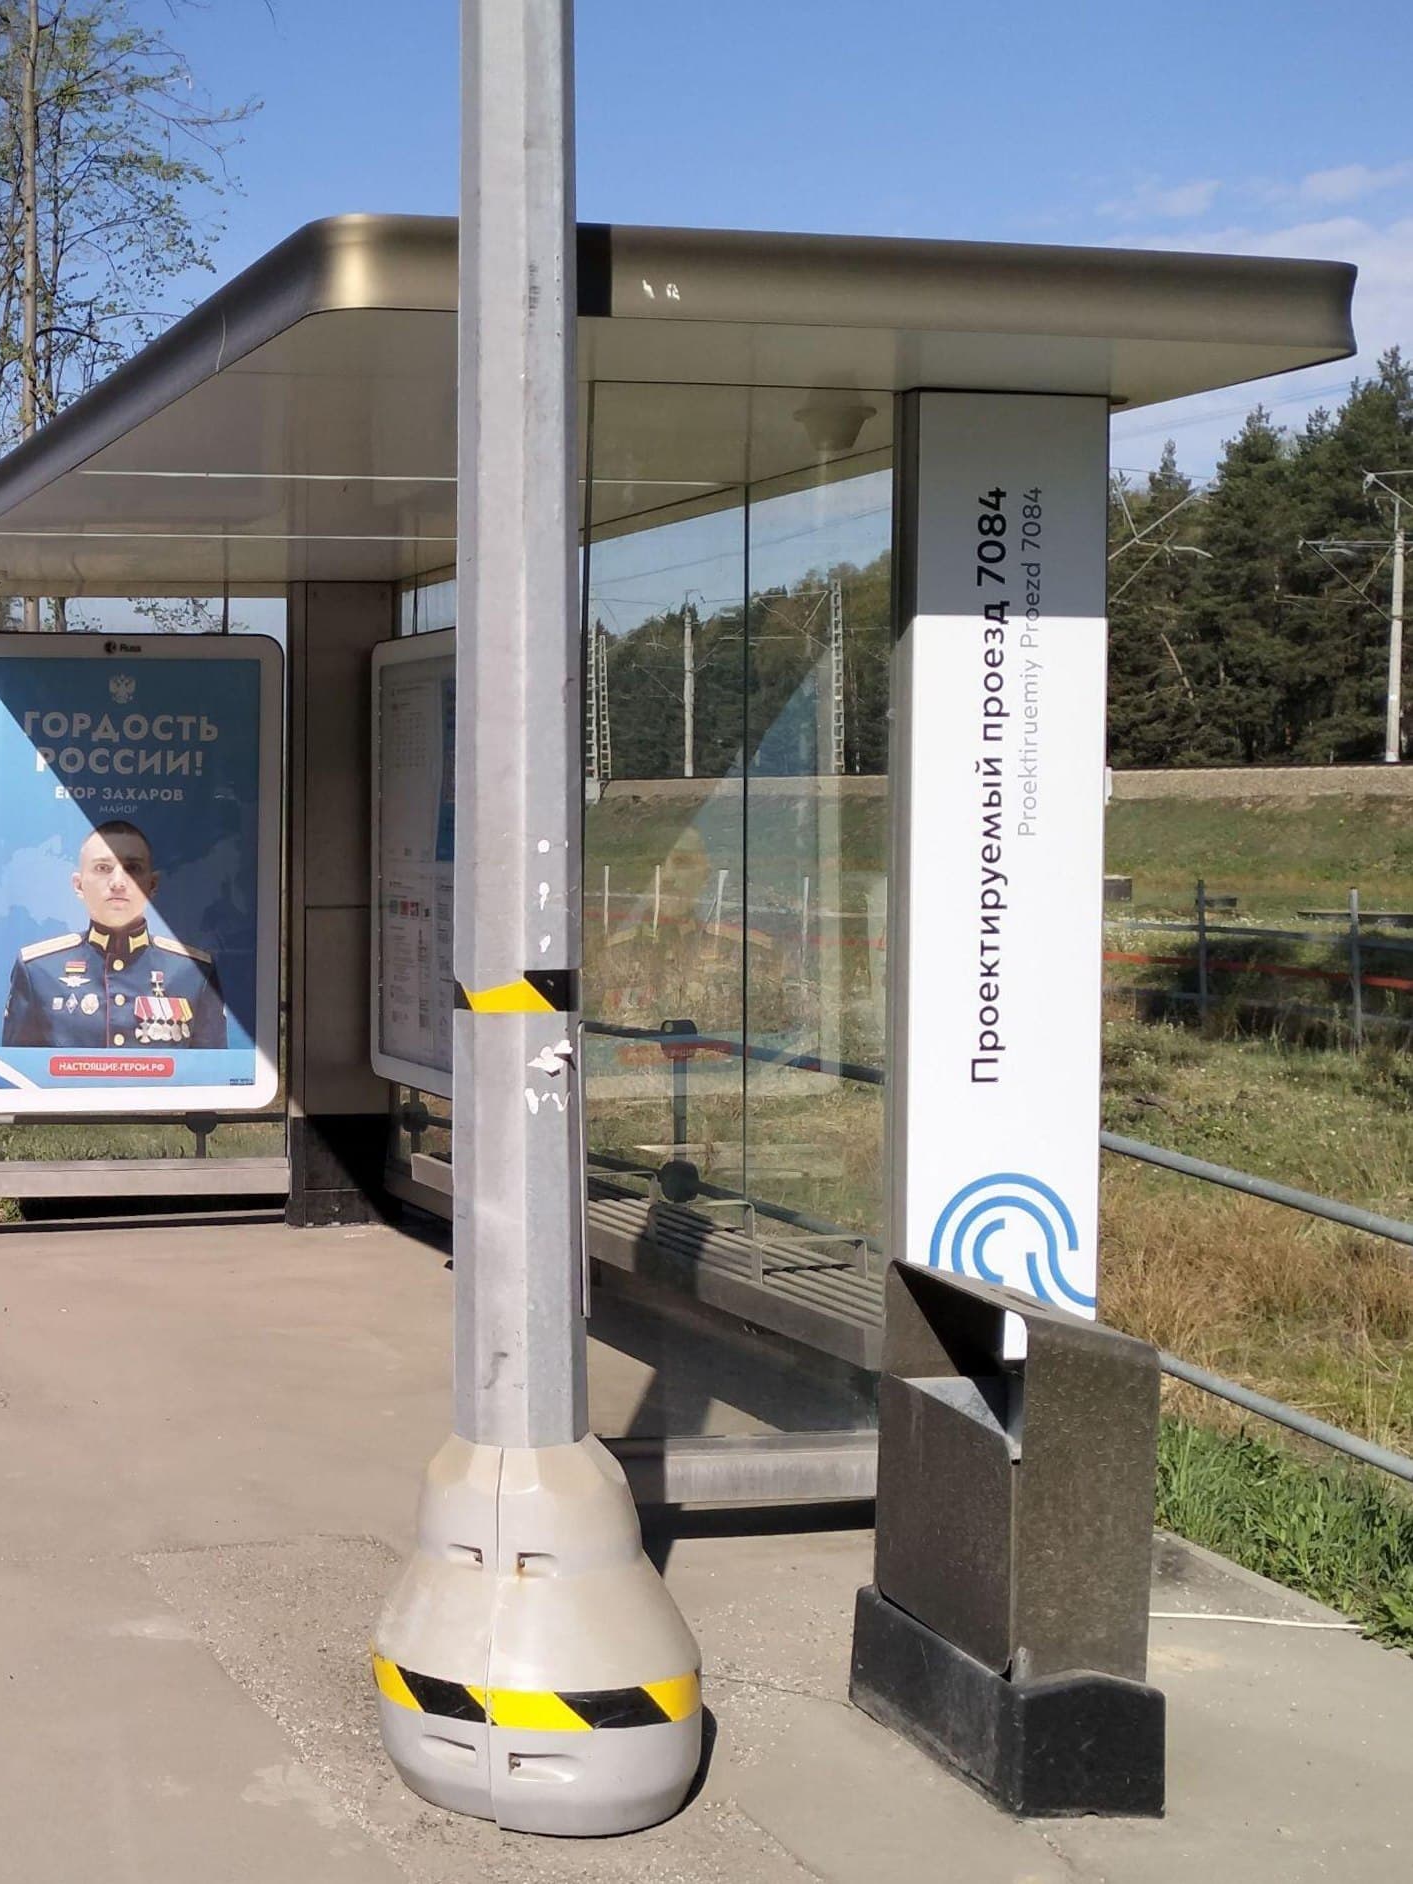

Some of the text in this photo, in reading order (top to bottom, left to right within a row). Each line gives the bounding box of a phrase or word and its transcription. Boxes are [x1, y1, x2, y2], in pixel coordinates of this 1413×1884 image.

[1018, 486, 1043, 836] Proektiruemiy Proezd 7084
[24, 711, 219, 743] ГОРДОСТЬ
[35, 747, 204, 777] РОССИИ!
[54, 786, 185, 801] ЕГОР ЗАХАРОВ
[971, 487, 1010, 1083] Проектируемый проезд 7084
[58, 1062, 167, 1073] НАСТОЯЩИЕ-ГЕРОИ.РФ
